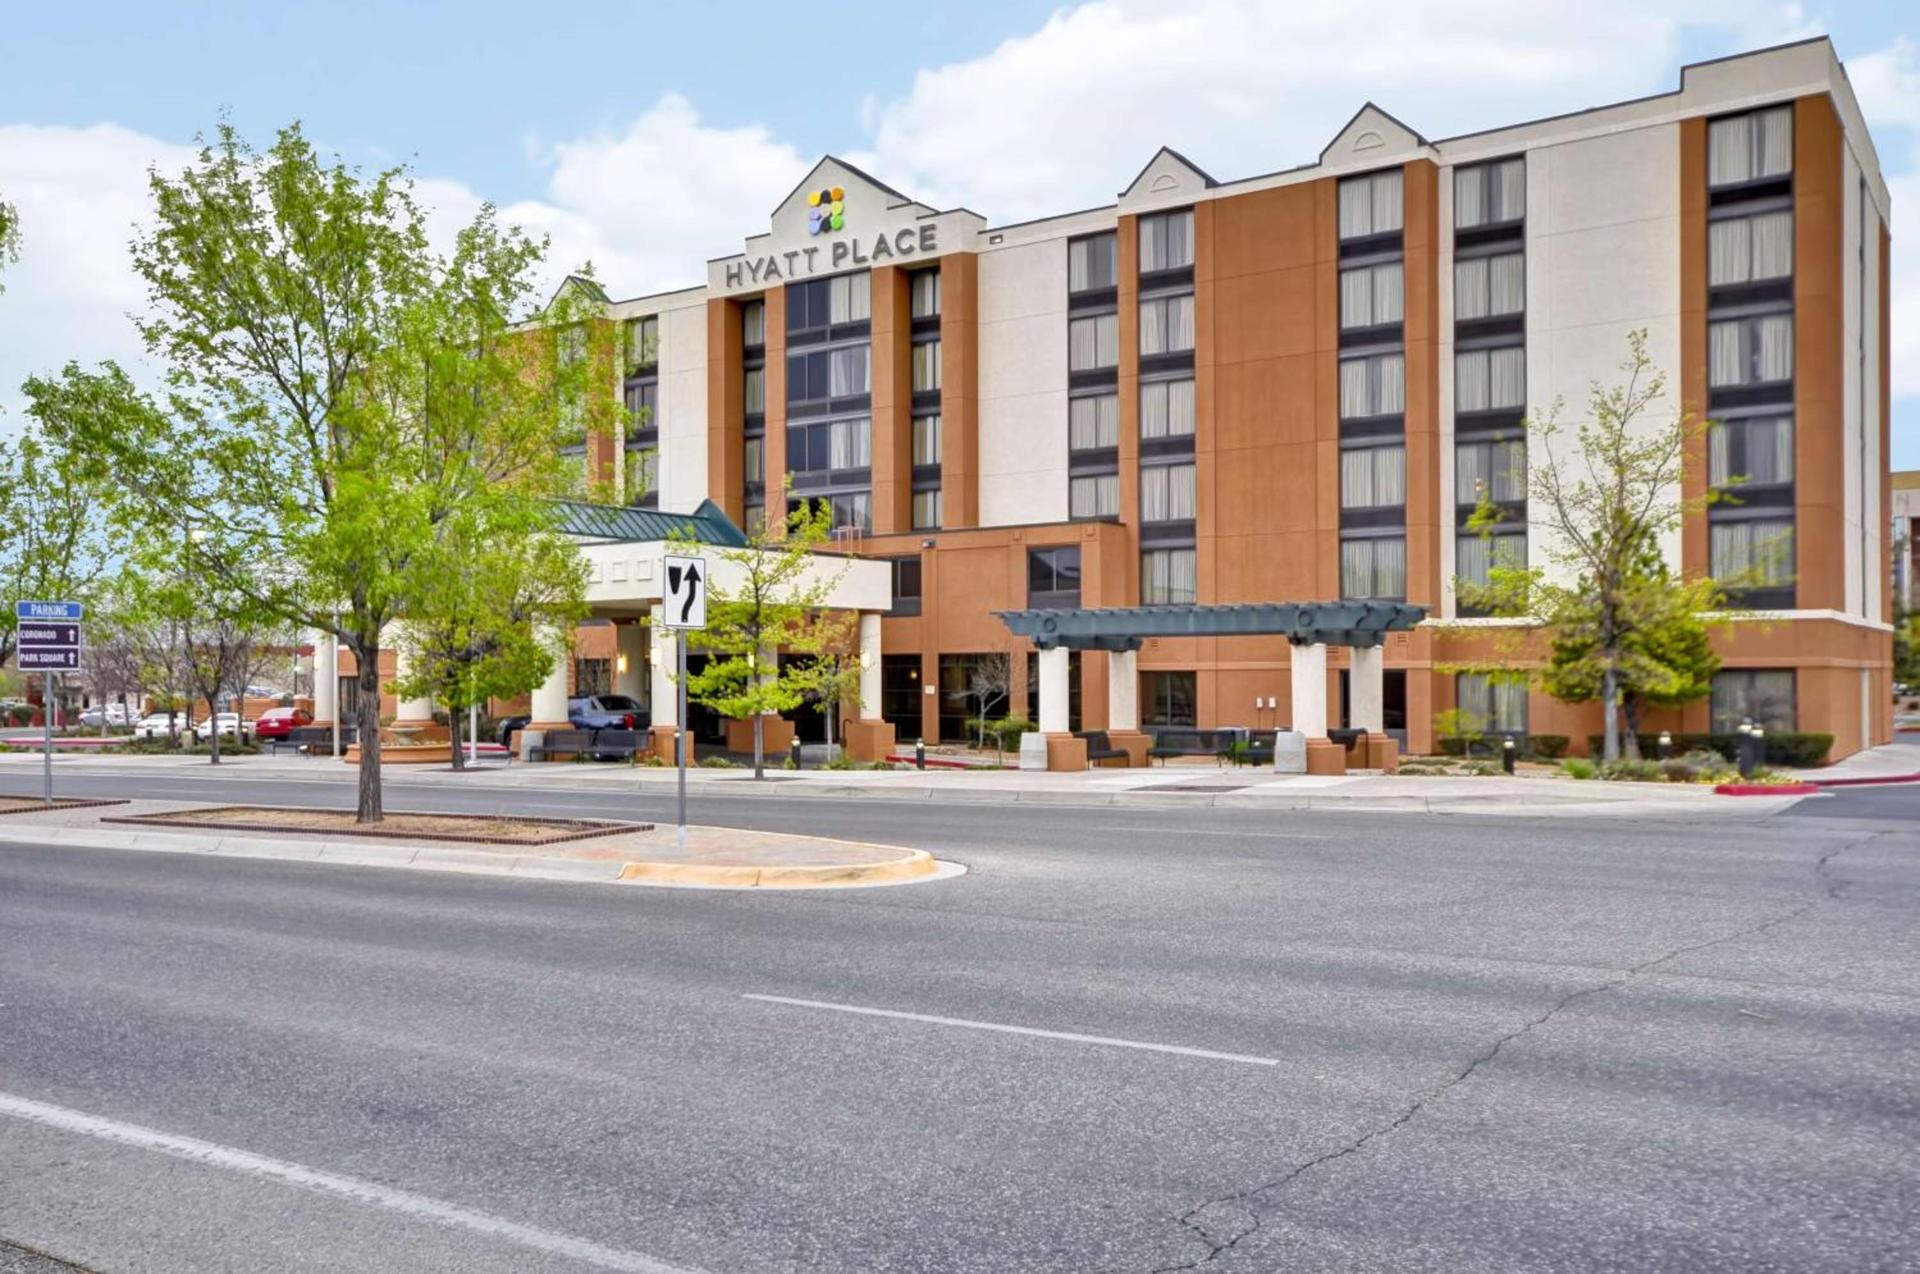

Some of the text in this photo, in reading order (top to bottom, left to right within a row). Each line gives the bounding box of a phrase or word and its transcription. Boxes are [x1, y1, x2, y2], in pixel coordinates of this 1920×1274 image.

[726, 224, 938, 288] HYATT PLACE
[30, 604, 68, 616] PARKING
[20, 630, 57, 640] CORONADO
[20, 653, 65, 663] PARK SQUARE
